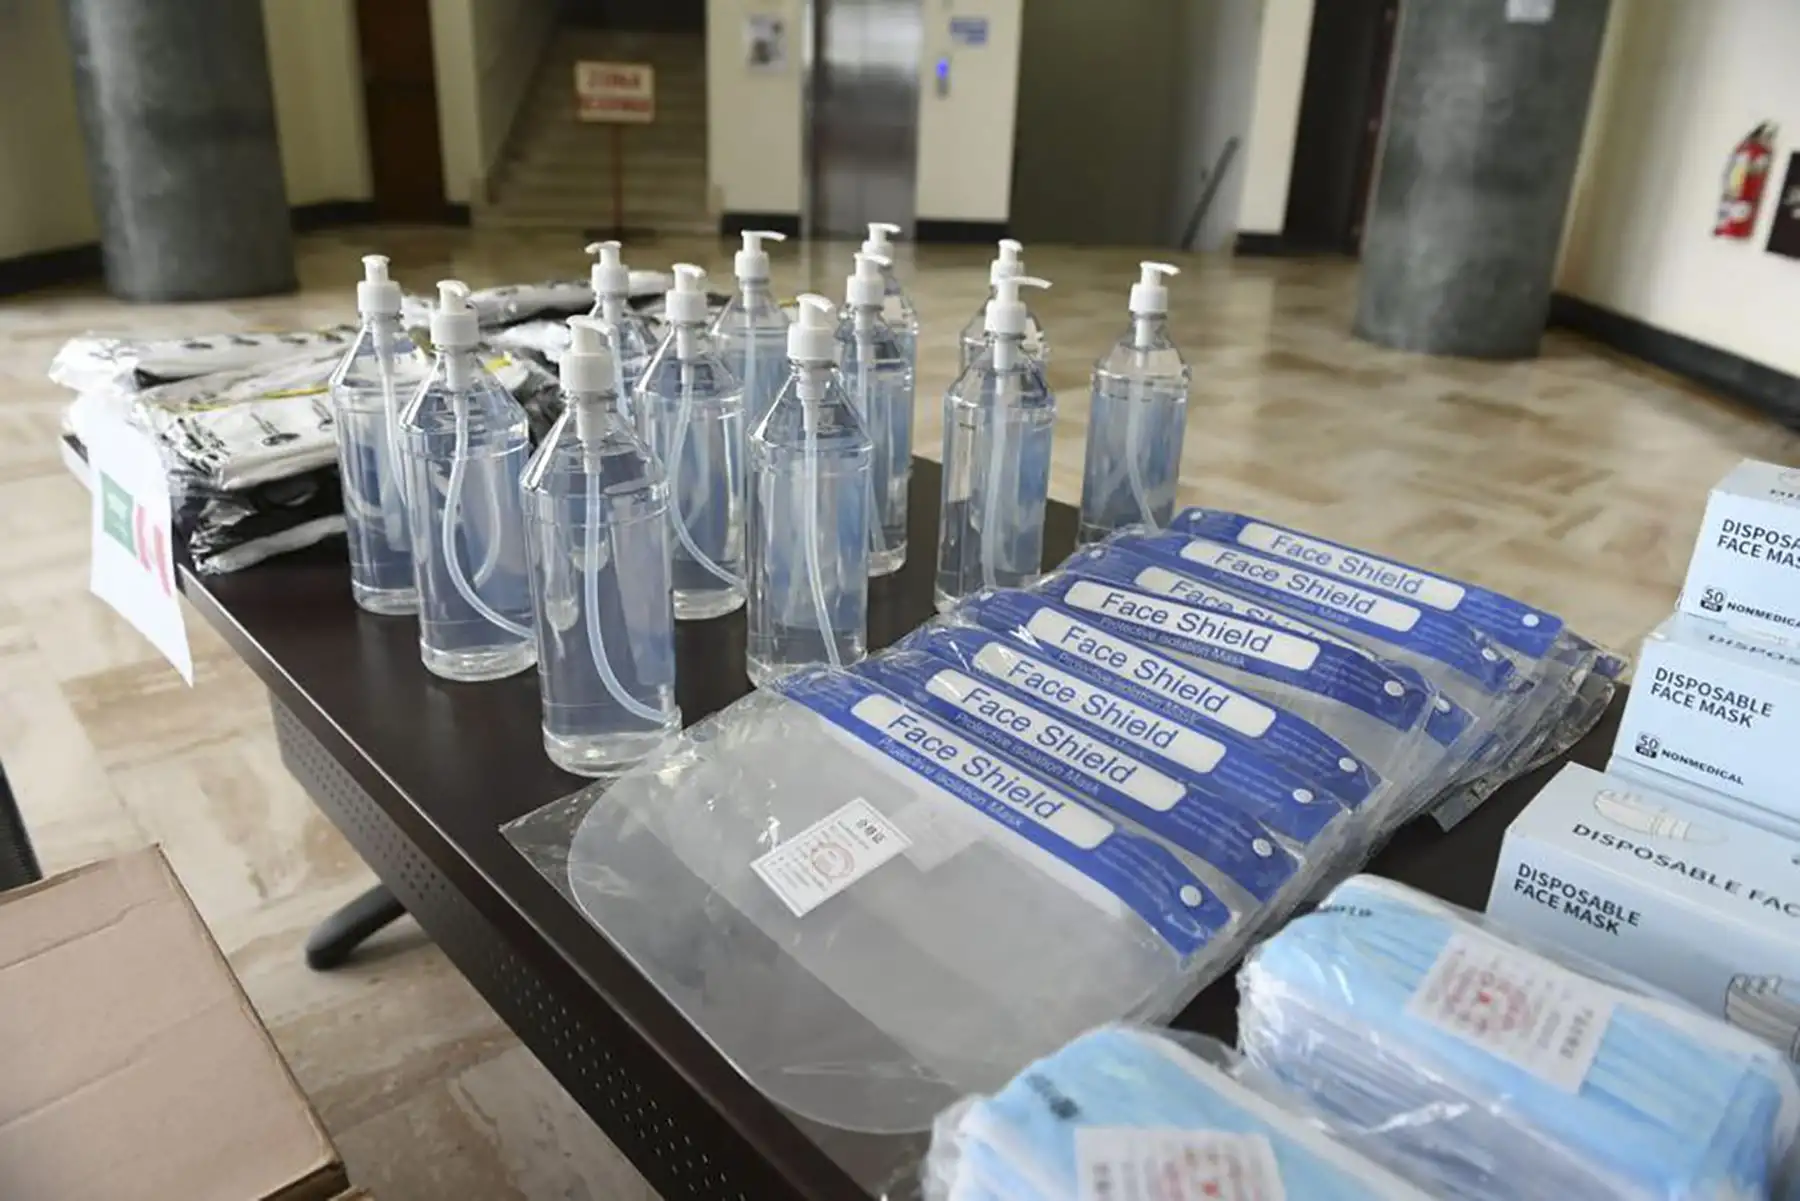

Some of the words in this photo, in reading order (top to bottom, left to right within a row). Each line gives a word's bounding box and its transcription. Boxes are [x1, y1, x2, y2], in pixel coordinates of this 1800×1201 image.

[1270, 534, 1333, 566] Face
[1338, 555, 1424, 595] Shield
[1717, 534, 1763, 558] FACE
[1214, 551, 1280, 582] Face
[1286, 574, 1377, 614] Shield
[1705, 588, 1724, 603] 50
[1100, 592, 1168, 624] Face
[1176, 612, 1273, 653] Shield
[1060, 625, 1128, 668] Face
[1134, 659, 1230, 714] Shield
[1655, 667, 1773, 718] DISPOSABLE
[1007, 659, 1076, 703] Face
[1081, 693, 1180, 749] Shield
[1650, 682, 1696, 709] FACE
[1699, 699, 1753, 729] MASK
[887, 713, 958, 762] Face
[961, 755, 1066, 820] Shield
[962, 687, 1031, 733] Face
[1036, 725, 1138, 785] Shield
[1640, 734, 1660, 750] 50
[1661, 749, 1744, 785] NONMEDICAL
[1571, 823, 1742, 895] DISPOSABLE
[1513, 878, 1561, 909] FACE
[1563, 902, 1620, 936] MASK
[1517, 862, 1642, 928] DISPOSABLE
